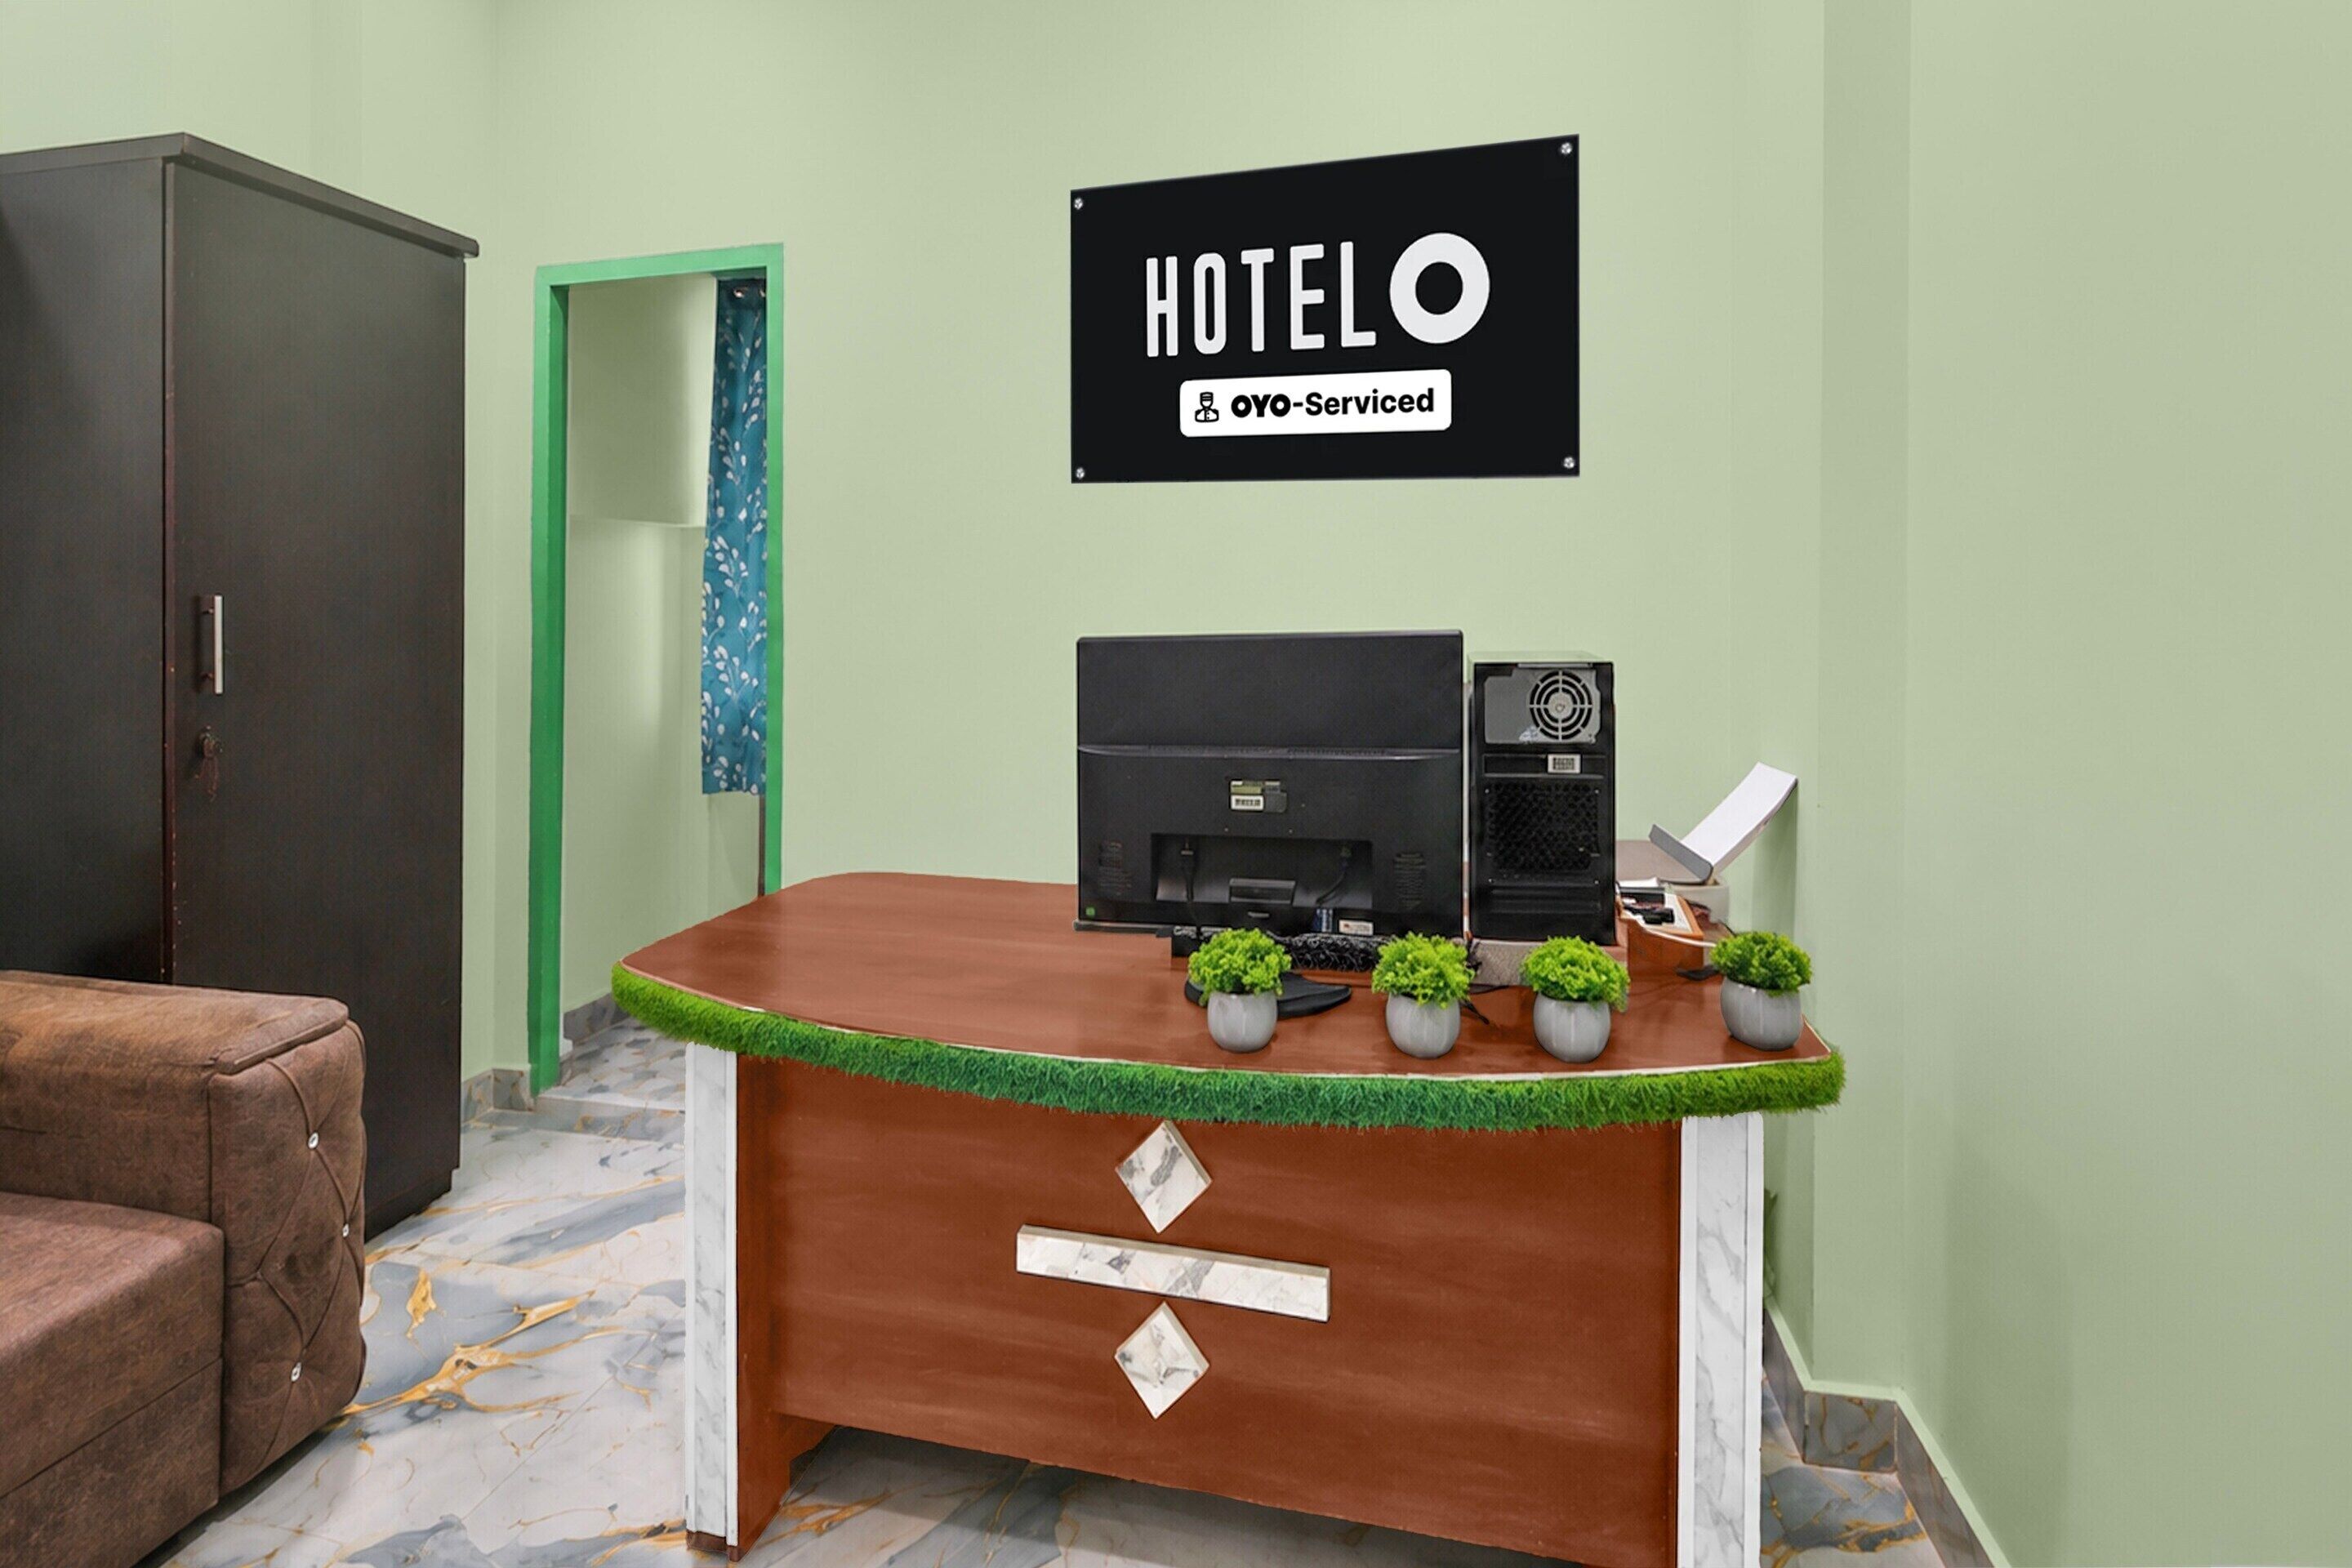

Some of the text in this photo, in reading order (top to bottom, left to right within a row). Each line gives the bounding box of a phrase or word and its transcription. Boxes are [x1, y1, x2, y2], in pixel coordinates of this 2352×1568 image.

[1146, 232, 1490, 358] HOTEL O
[1231, 387, 1434, 418] OYO-Serviced
